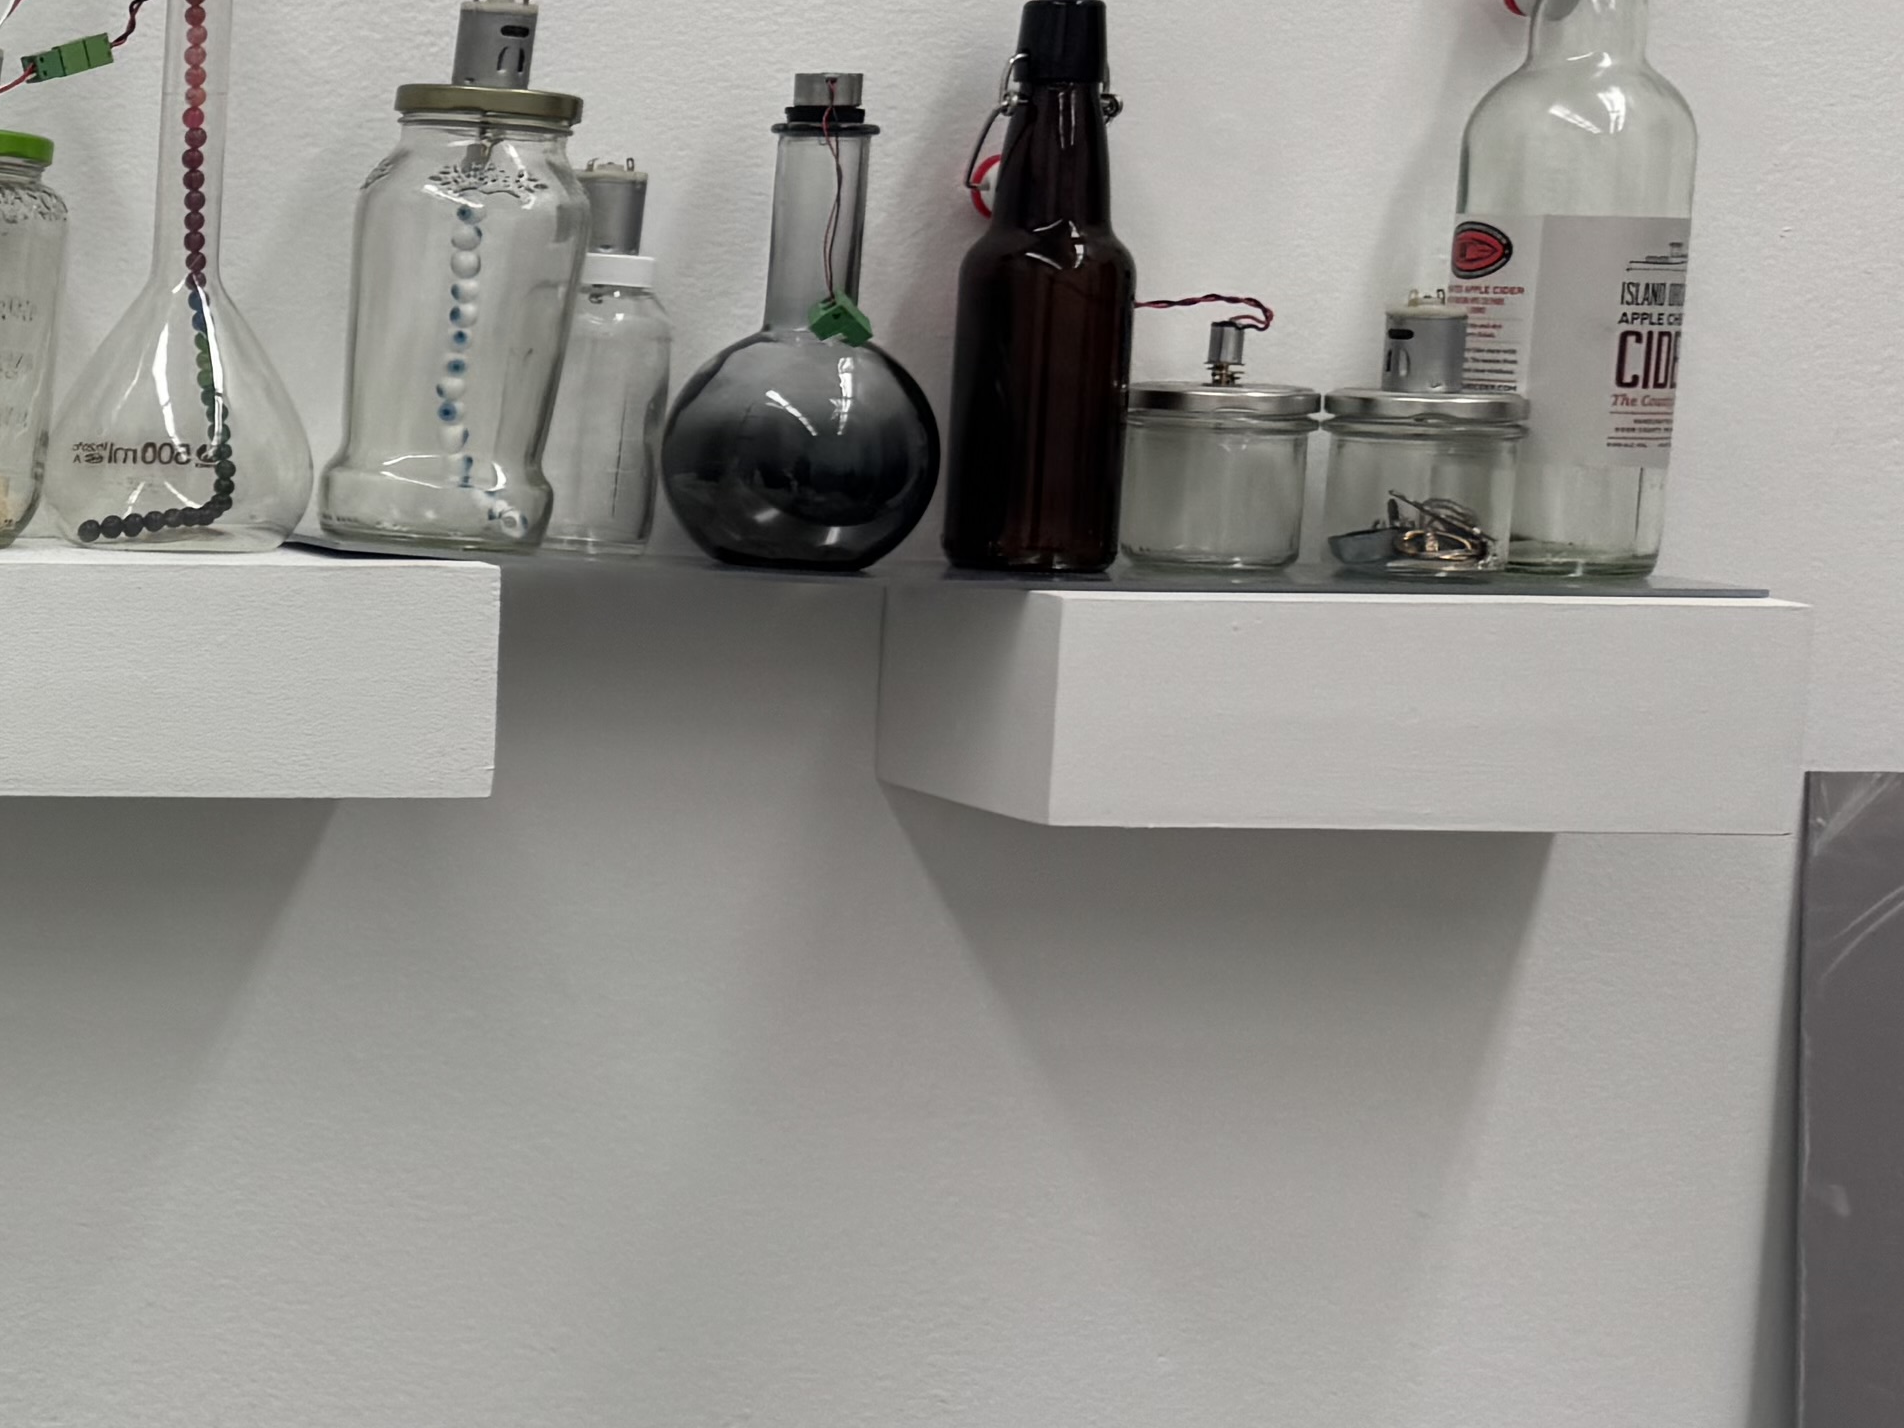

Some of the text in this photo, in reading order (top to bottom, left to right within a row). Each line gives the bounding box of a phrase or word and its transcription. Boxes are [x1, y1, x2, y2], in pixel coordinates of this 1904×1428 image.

[1620, 281, 1666, 306] ISLAND
[1617, 311, 1665, 326] APPLE
[1611, 393, 1638, 407] The
